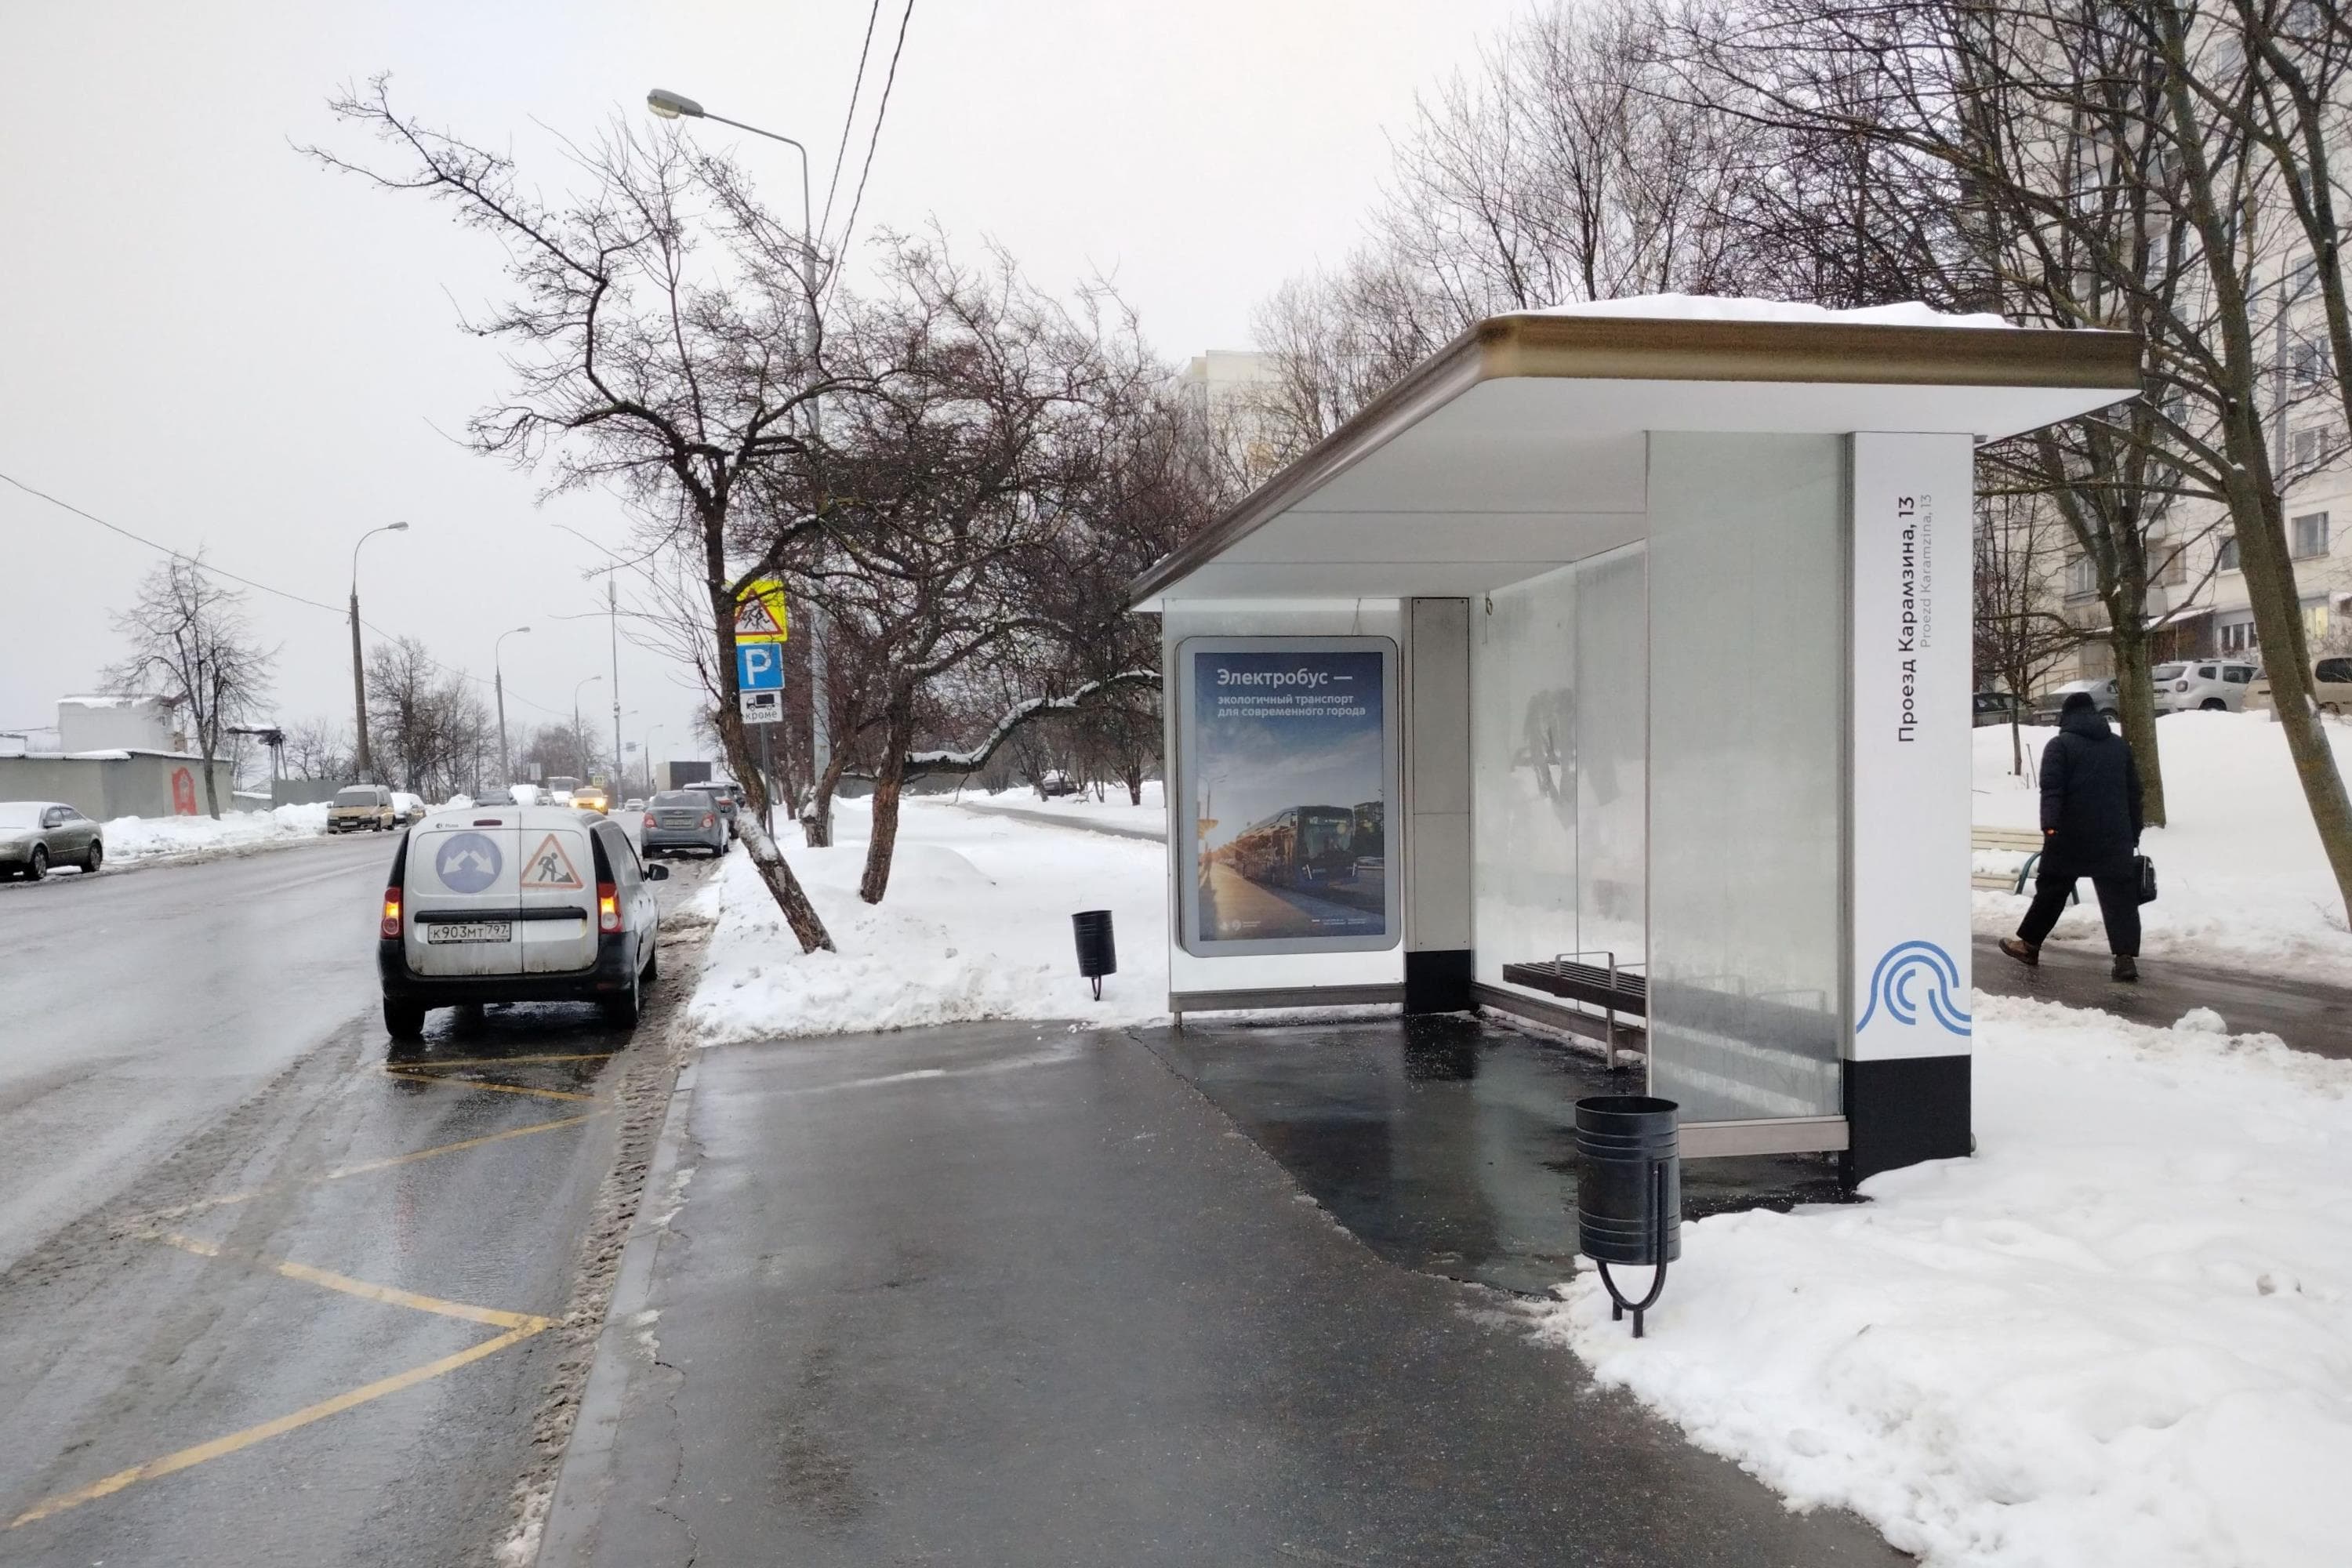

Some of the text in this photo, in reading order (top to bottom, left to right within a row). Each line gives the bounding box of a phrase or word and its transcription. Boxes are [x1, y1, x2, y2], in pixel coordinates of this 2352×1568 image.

[1921, 495, 1932, 647] Proezd Karamzina, 13
[1899, 497, 1918, 742] Проезд Карамзина, 13
[746, 649, 771, 684] P
[1218, 669, 1328, 688] Электробус
[1218, 695, 1354, 706] экологичный транспорт
[746, 711, 777, 721] кроме
[1218, 706, 1366, 718] для современного города
[487, 925, 506, 934] 797
